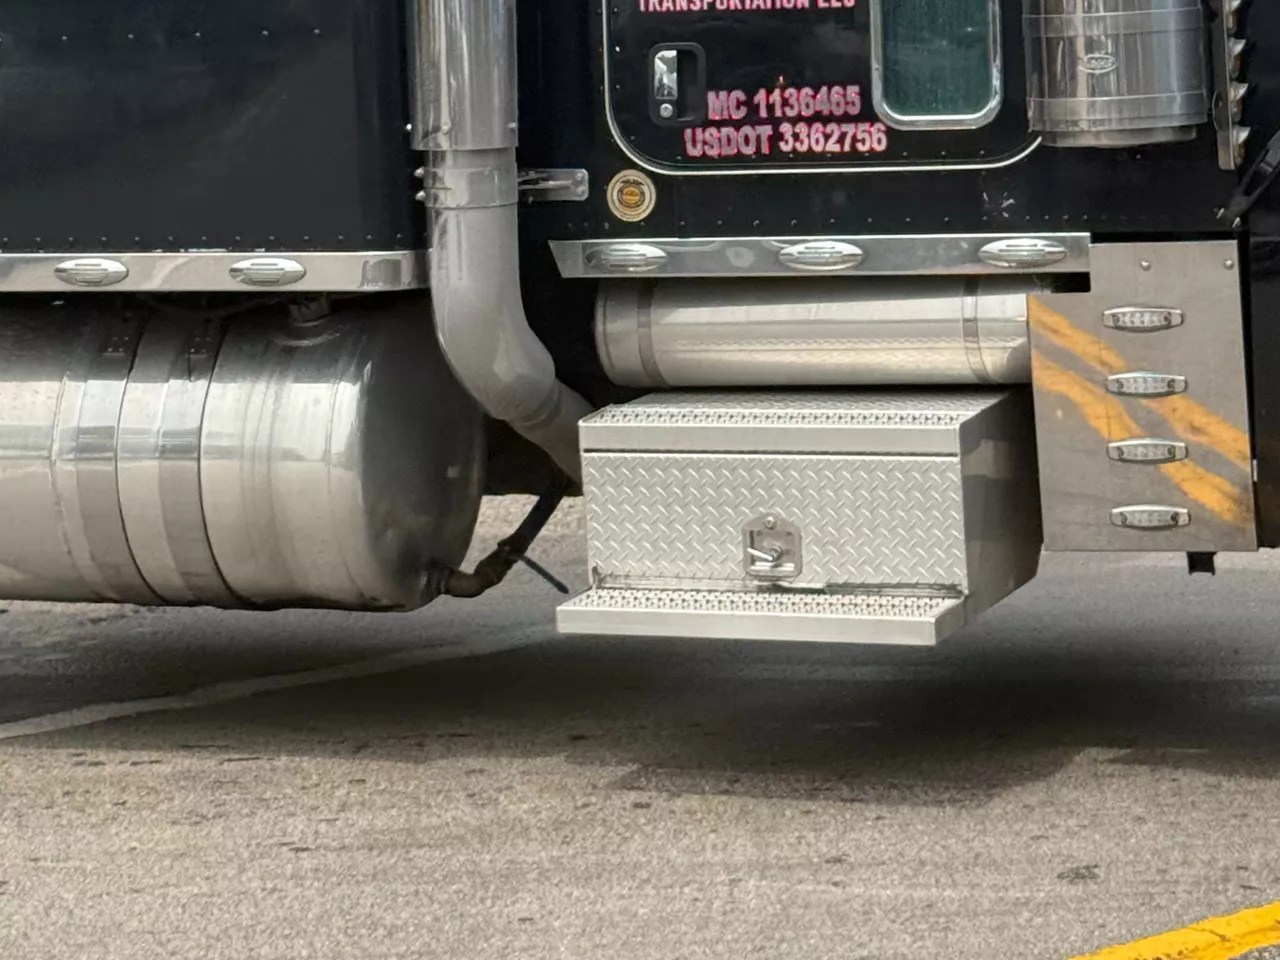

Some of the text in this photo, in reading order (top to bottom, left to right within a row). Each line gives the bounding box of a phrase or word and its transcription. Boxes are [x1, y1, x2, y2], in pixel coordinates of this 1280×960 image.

[707, 85, 861, 121] MC 1136465
[683, 122, 888, 158] USDOT 3362756
